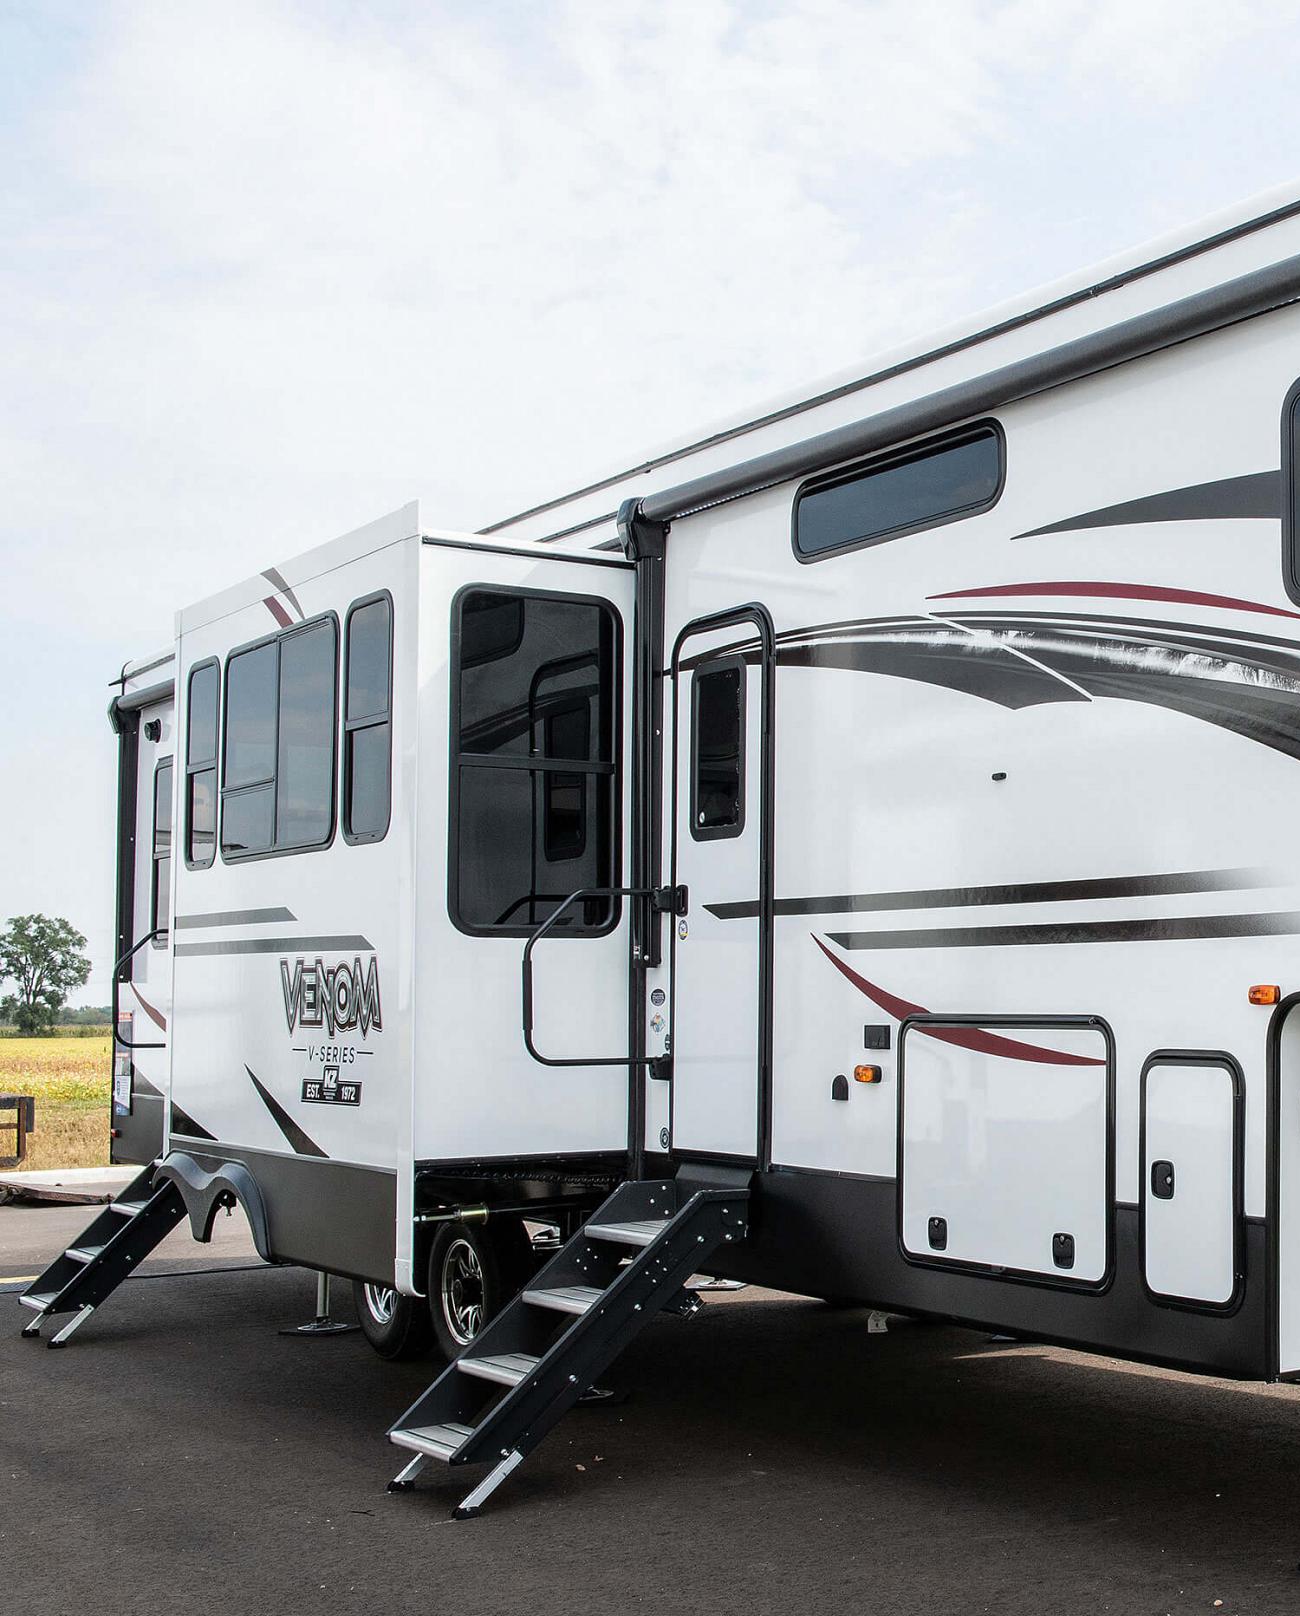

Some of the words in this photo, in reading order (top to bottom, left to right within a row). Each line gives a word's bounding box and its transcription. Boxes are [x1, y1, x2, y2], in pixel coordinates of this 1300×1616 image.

[280, 954, 383, 1040] VENOM
[308, 1045, 355, 1064] V-SERIES
[323, 1069, 338, 1089] KZ
[306, 1083, 320, 1099] EST.
[341, 1086, 356, 1101] 1972
